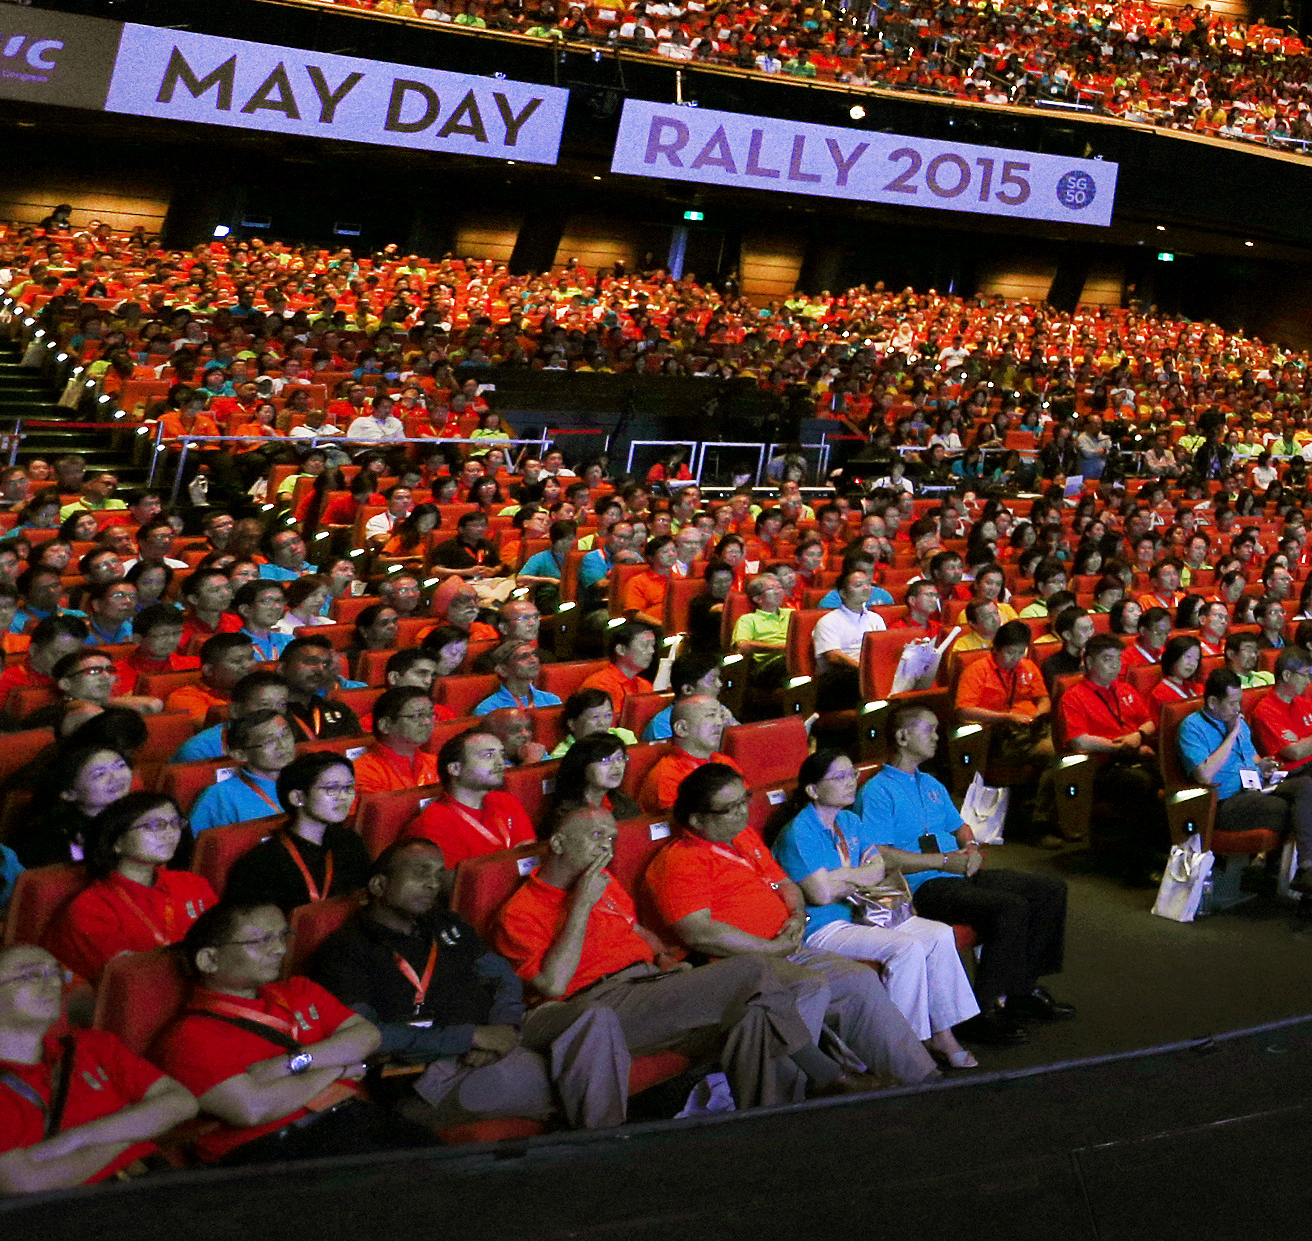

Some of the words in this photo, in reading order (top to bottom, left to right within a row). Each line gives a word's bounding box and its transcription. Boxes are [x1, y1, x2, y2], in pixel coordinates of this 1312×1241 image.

[157, 45, 364, 124] MAY
[386, 79, 544, 146] DAY
[645, 116, 869, 186] RALLY
[883, 147, 1031, 206] 2015
[1067, 176, 1087, 190] SG
[1065, 189, 1086, 203] 50
